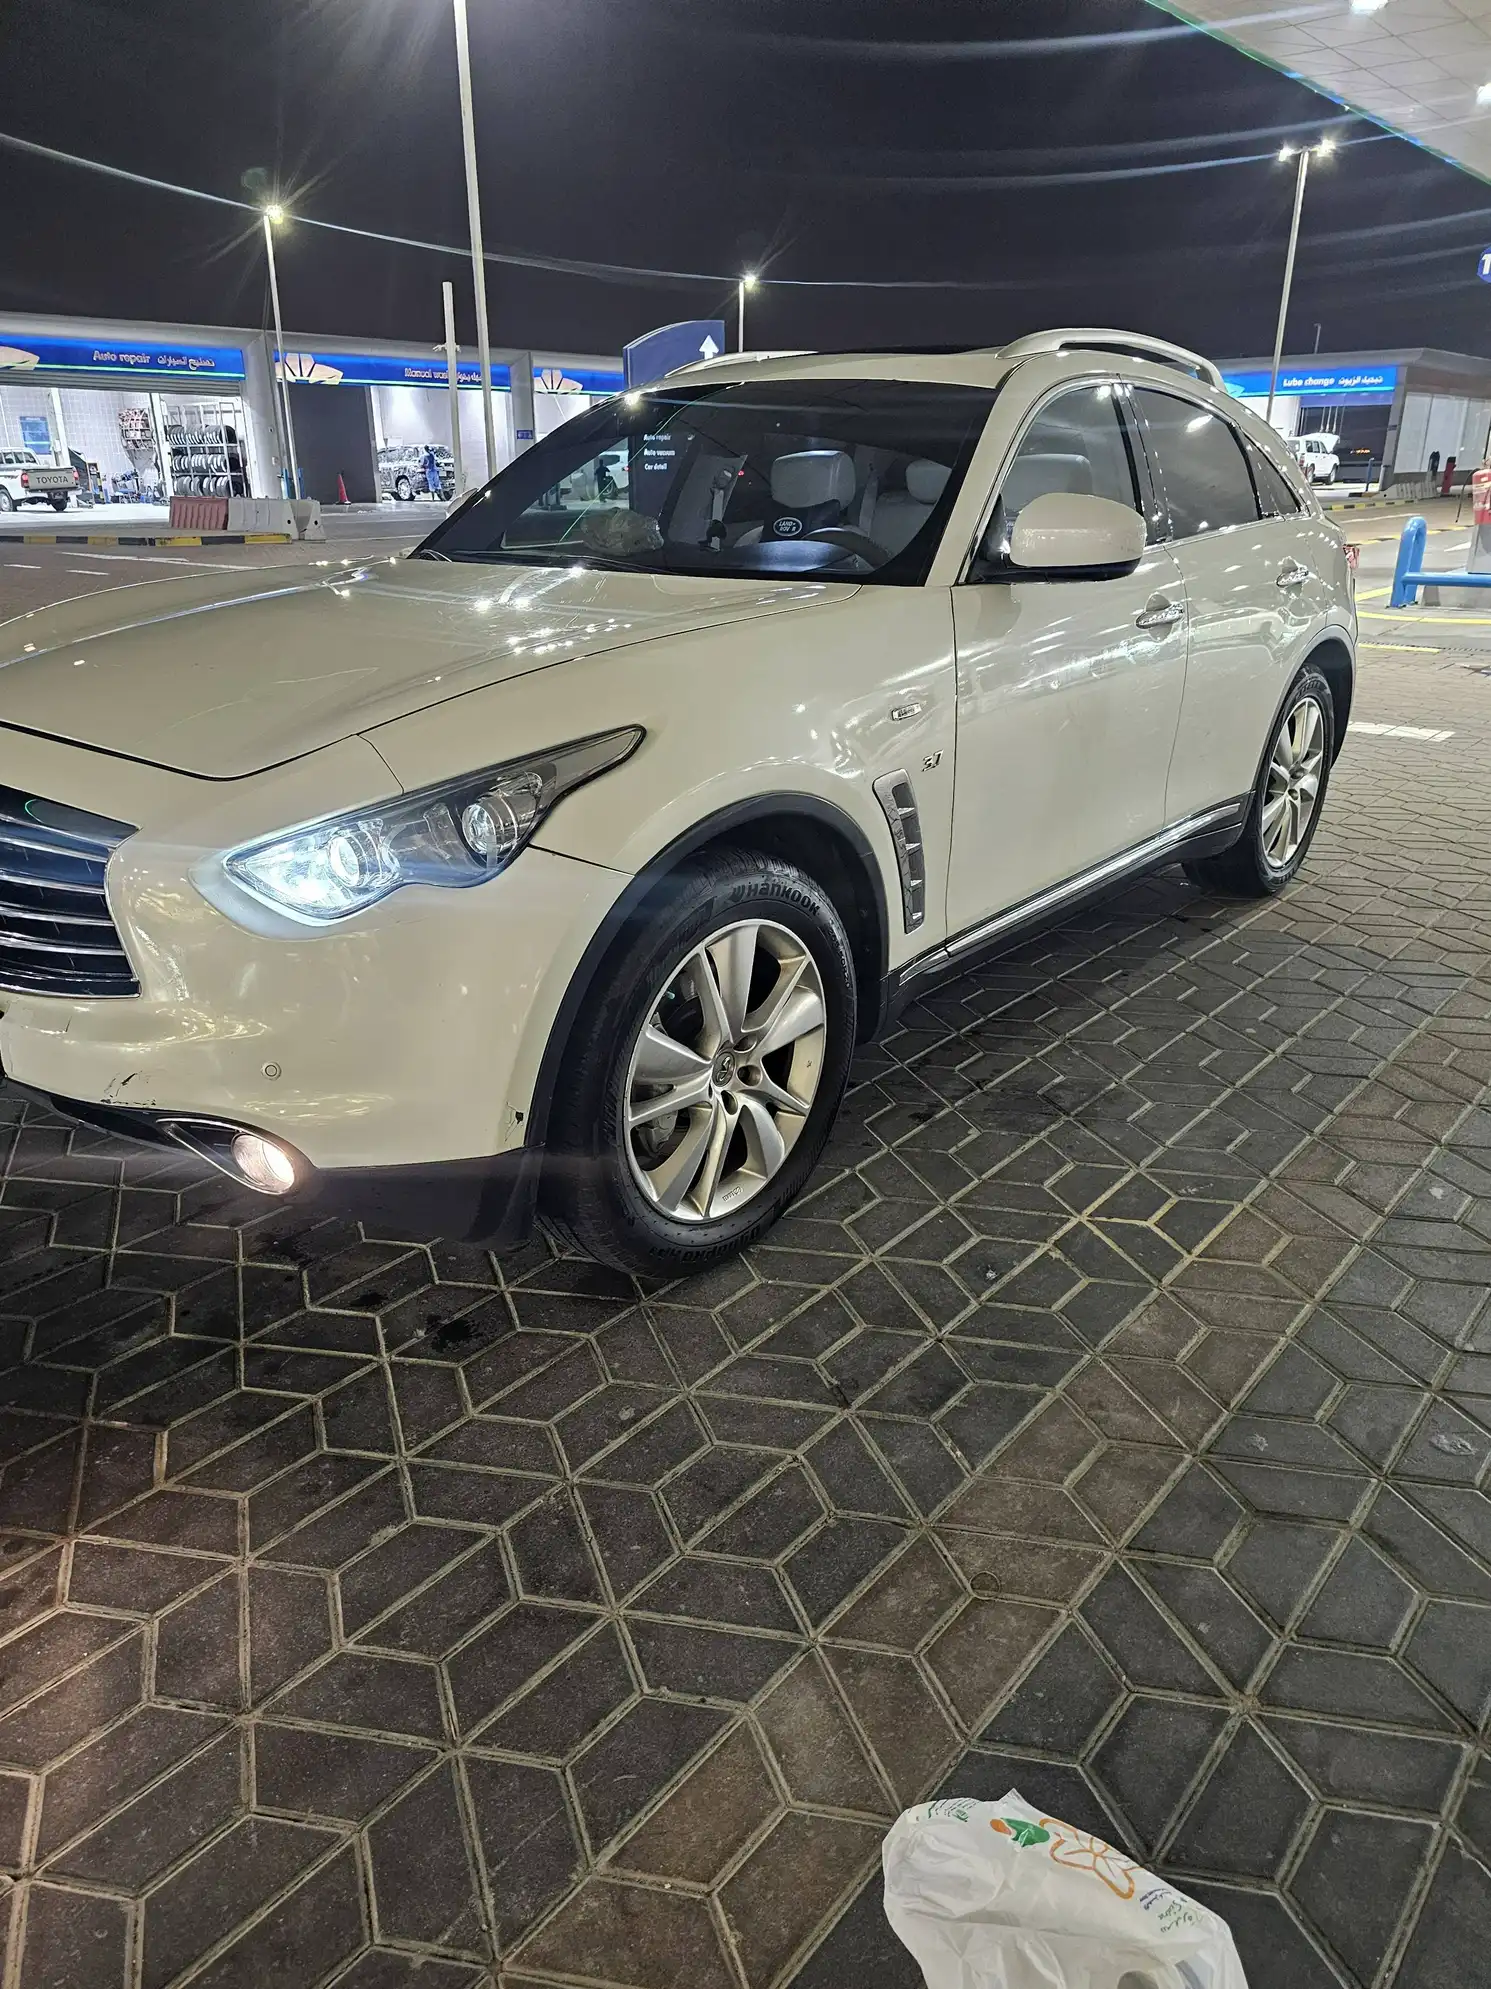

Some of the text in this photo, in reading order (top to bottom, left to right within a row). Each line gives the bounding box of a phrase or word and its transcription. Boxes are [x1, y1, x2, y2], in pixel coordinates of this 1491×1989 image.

[93, 350, 151, 365] Auto repair
[404, 368, 432, 378] Manual
[1283, 376, 1335, 387] Lube change
[36, 475, 69, 484] TOYOTA
